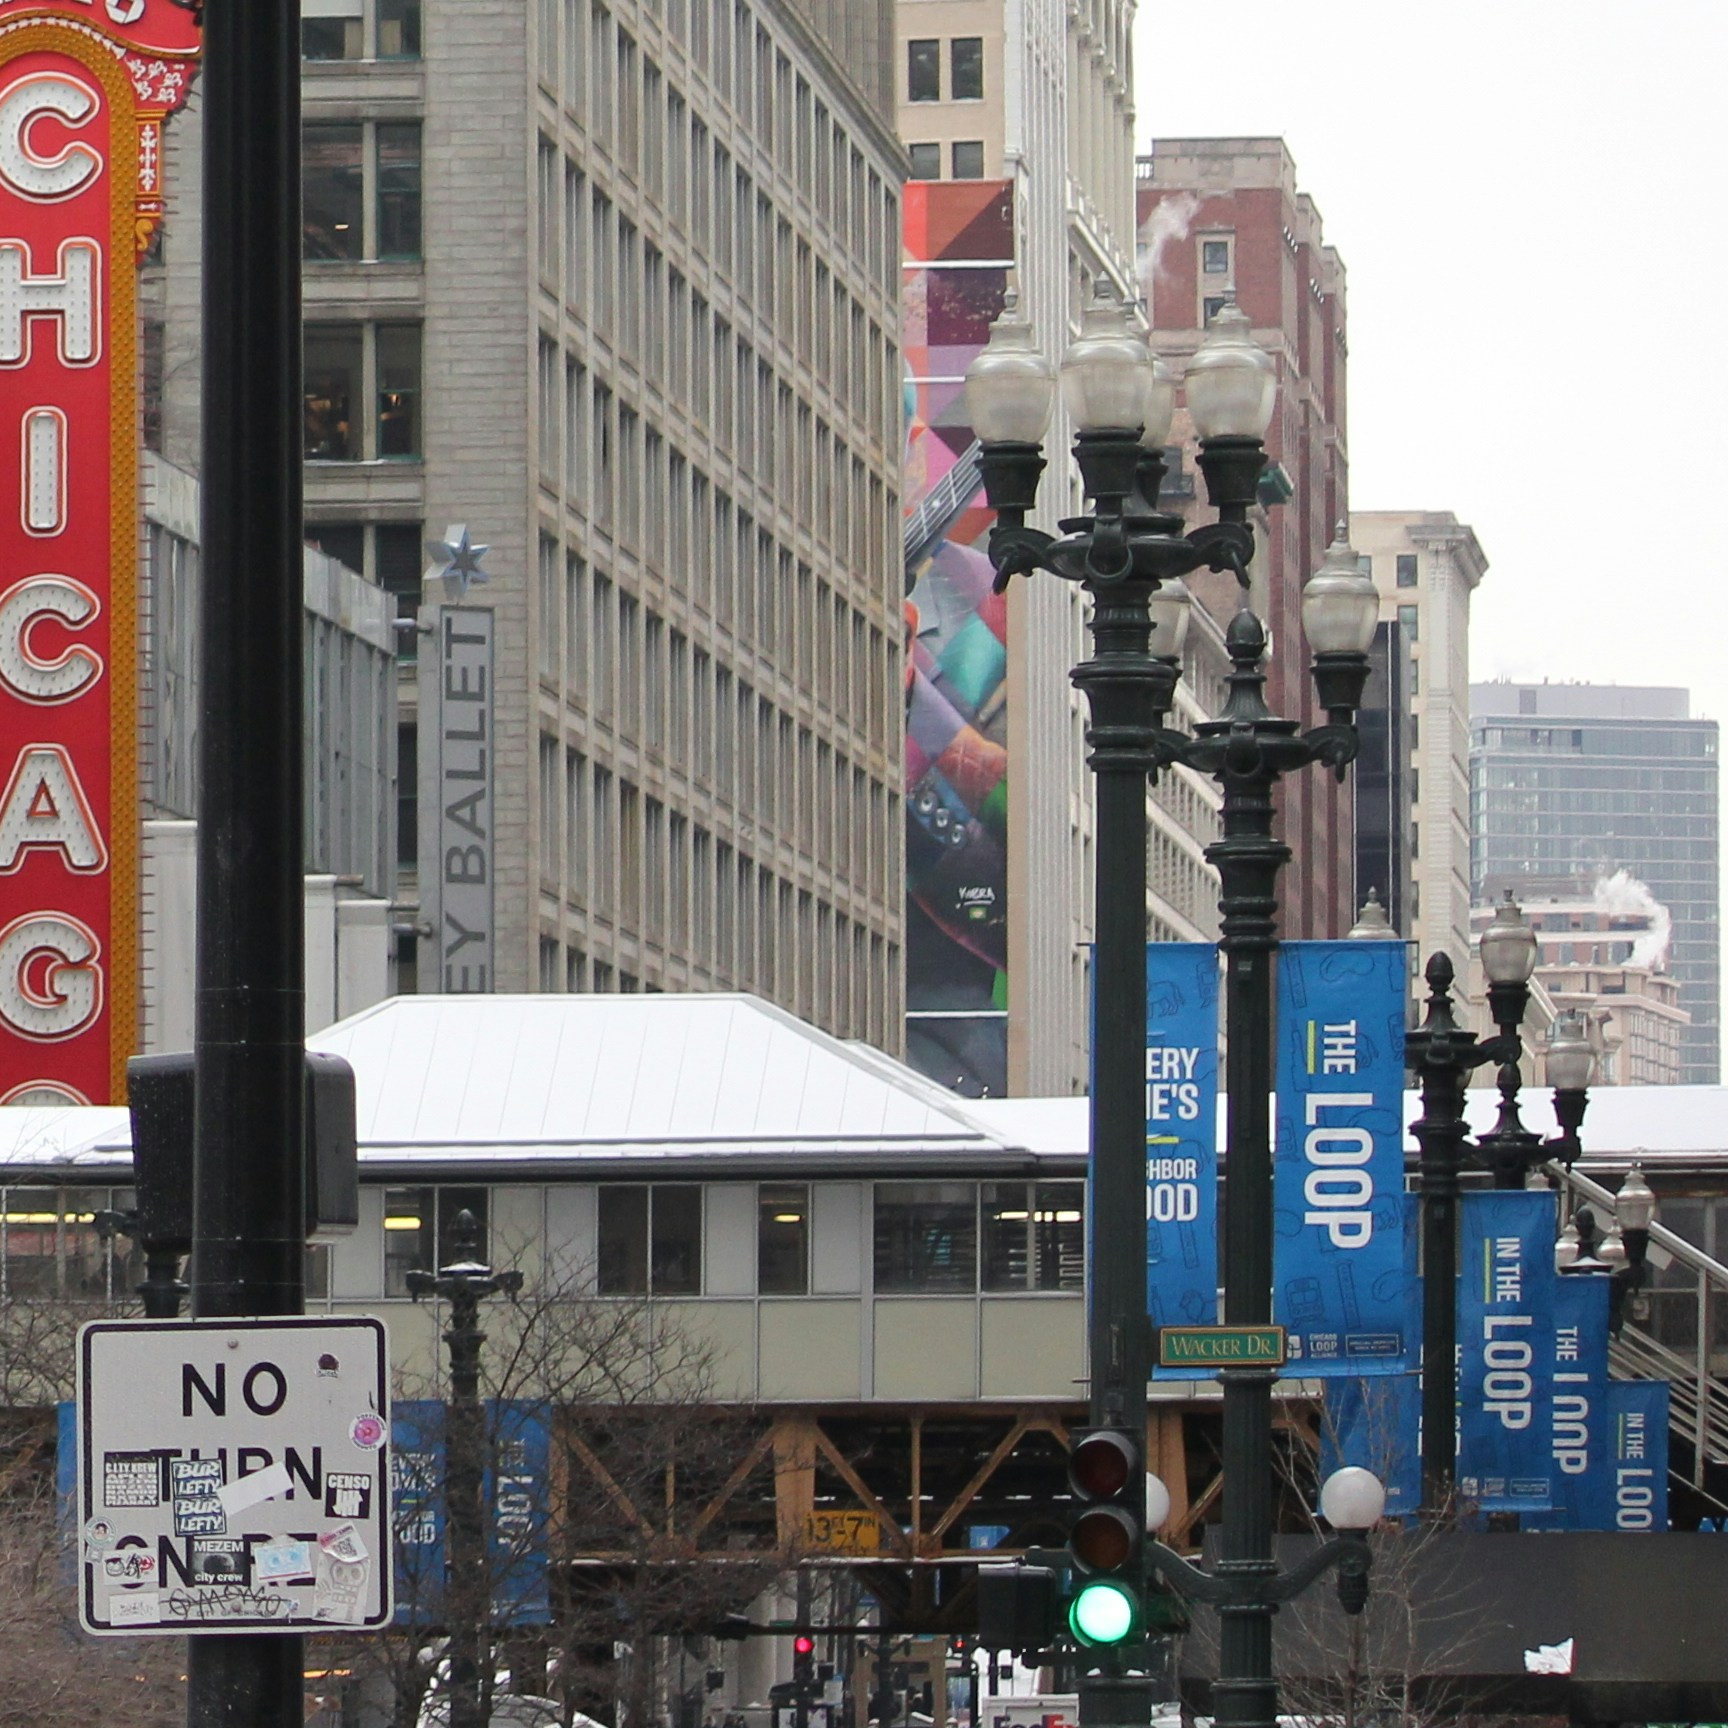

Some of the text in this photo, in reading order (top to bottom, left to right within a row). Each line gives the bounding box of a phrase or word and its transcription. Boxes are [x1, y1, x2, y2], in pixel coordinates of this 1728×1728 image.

[445, 616, 486, 884] BALLET
[1146, 1047, 1197, 1076] ERY
[1304, 1020, 1375, 1249] THE LOOP
[1146, 1158, 1197, 1180] HBOR
[1146, 1185, 1198, 1222] OOD
[1172, 1336, 1274, 1356] WACKER DR.
[1483, 1238, 1533, 1430] IN THE LOOP
[1556, 1326, 1578, 1361] THE
[1310, 1342, 1338, 1352] LOOP
[182, 1361, 287, 1417] NO
[328, 1475, 369, 1488] CENSO
[1616, 1413, 1652, 1532] IN THE LOO
[178, 1479, 220, 1494] LEFTY
[181, 1516, 222, 1531] LEFTY
[194, 1541, 244, 1553] MEZEM
[195, 1574, 243, 1584] city crew
